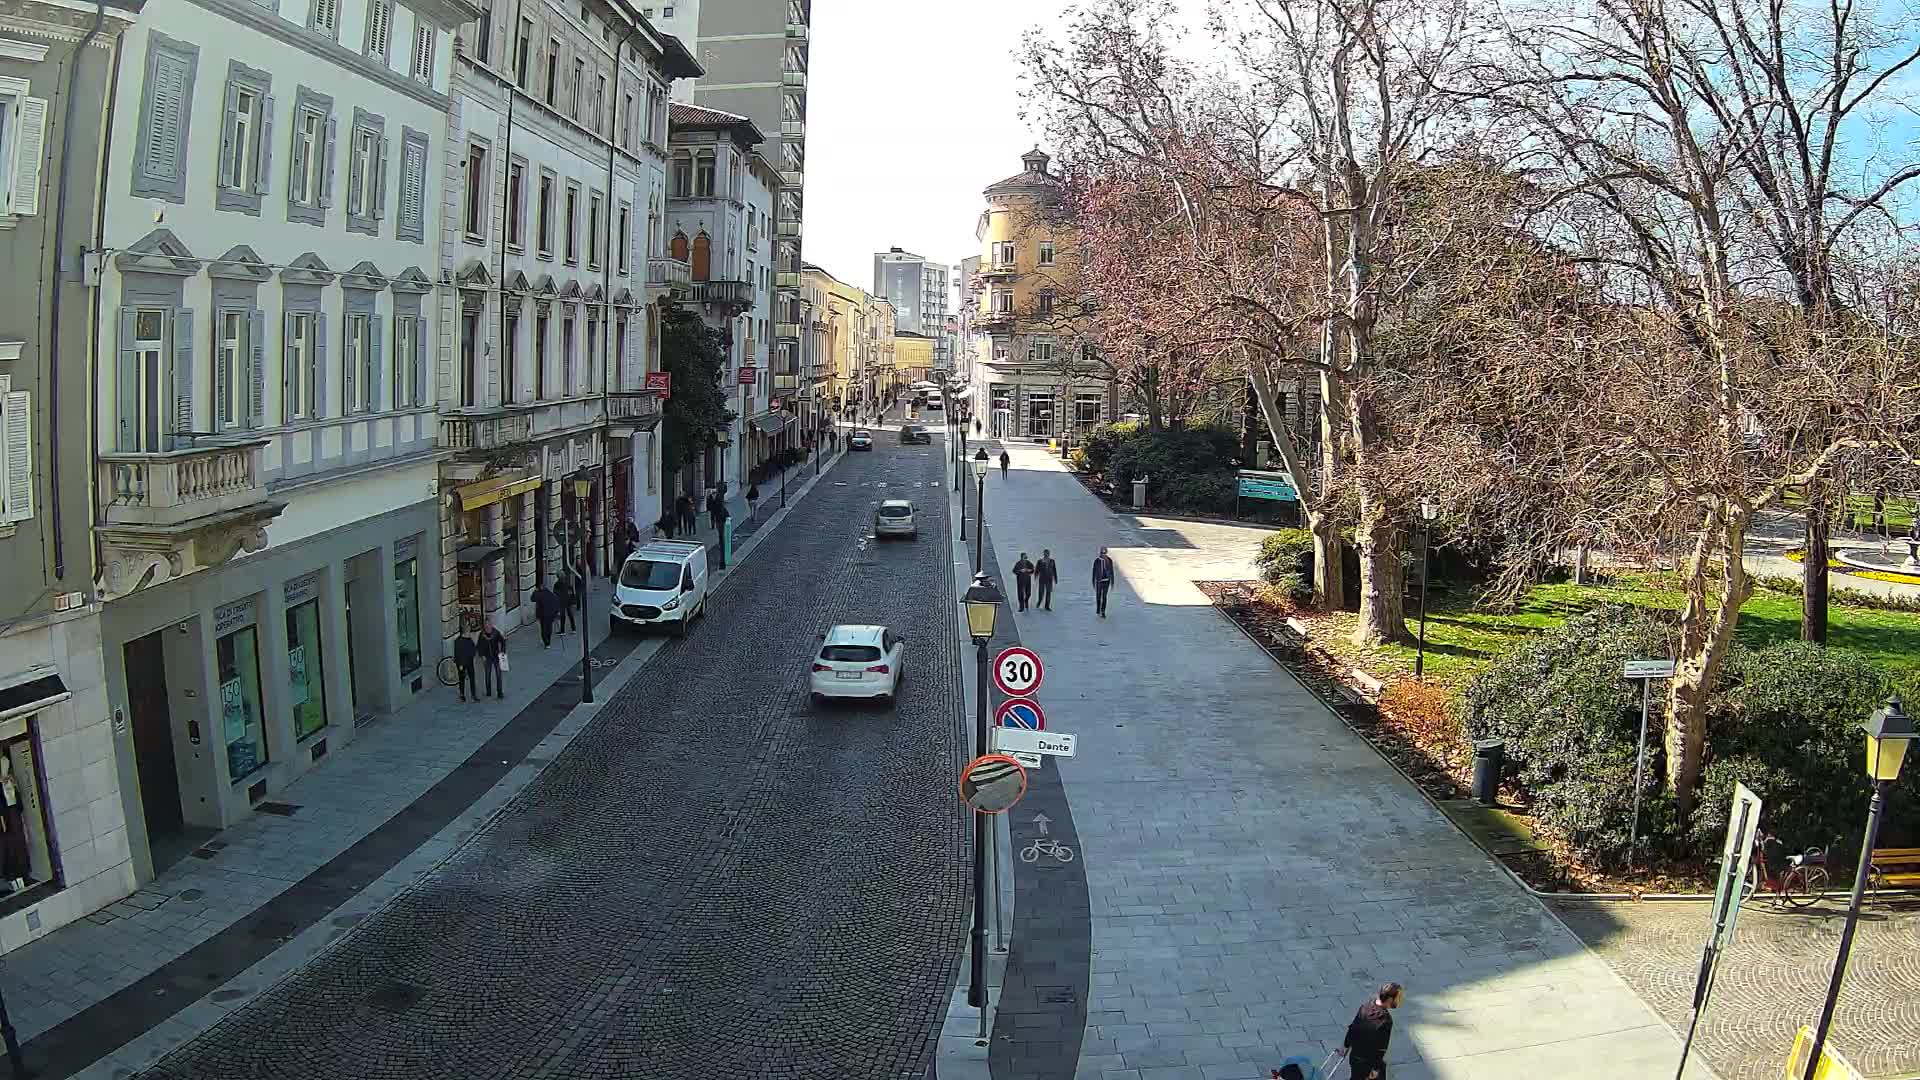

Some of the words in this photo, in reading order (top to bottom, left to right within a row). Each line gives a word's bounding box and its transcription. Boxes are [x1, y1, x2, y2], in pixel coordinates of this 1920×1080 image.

[1006, 661, 1032, 682] 30
[221, 680, 240, 703] 130
[1039, 741, 1069, 751] Dante
